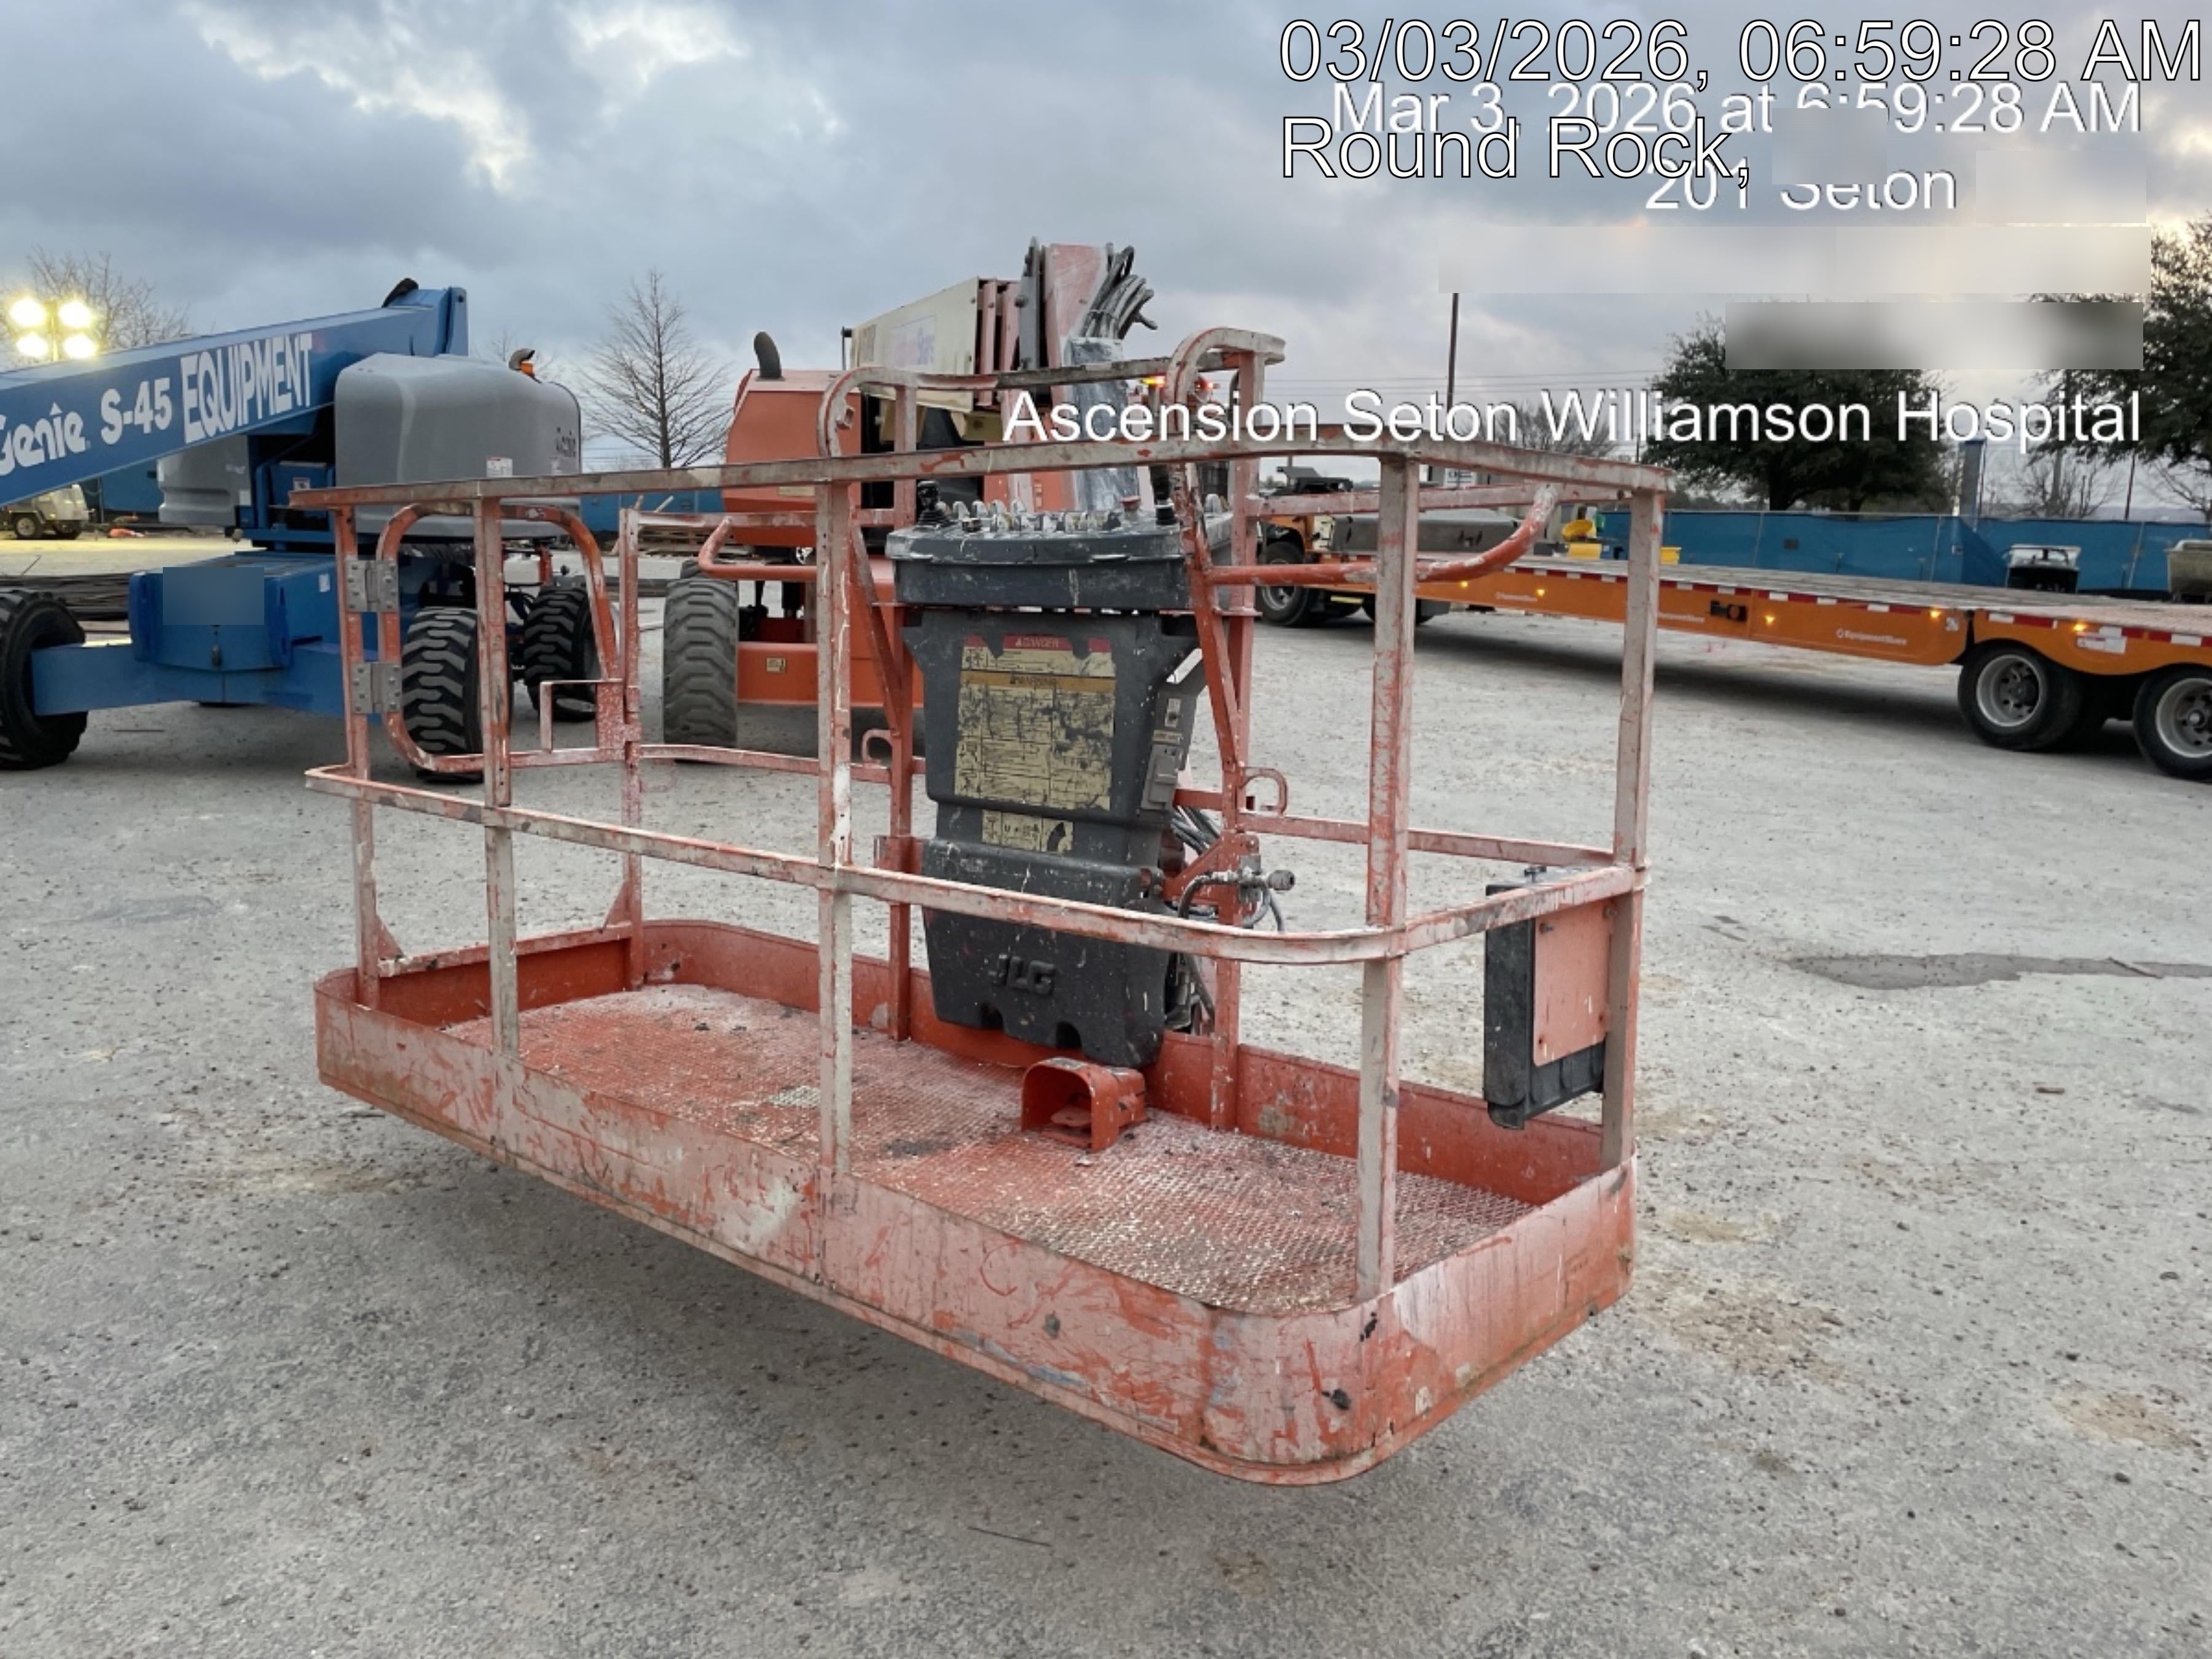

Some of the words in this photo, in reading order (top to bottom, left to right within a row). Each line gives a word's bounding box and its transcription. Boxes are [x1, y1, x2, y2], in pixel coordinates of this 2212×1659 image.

[0, 401, 87, 477] Genie
[100, 377, 172, 445] S-45
[180, 333, 312, 444] EQUIPMENT
